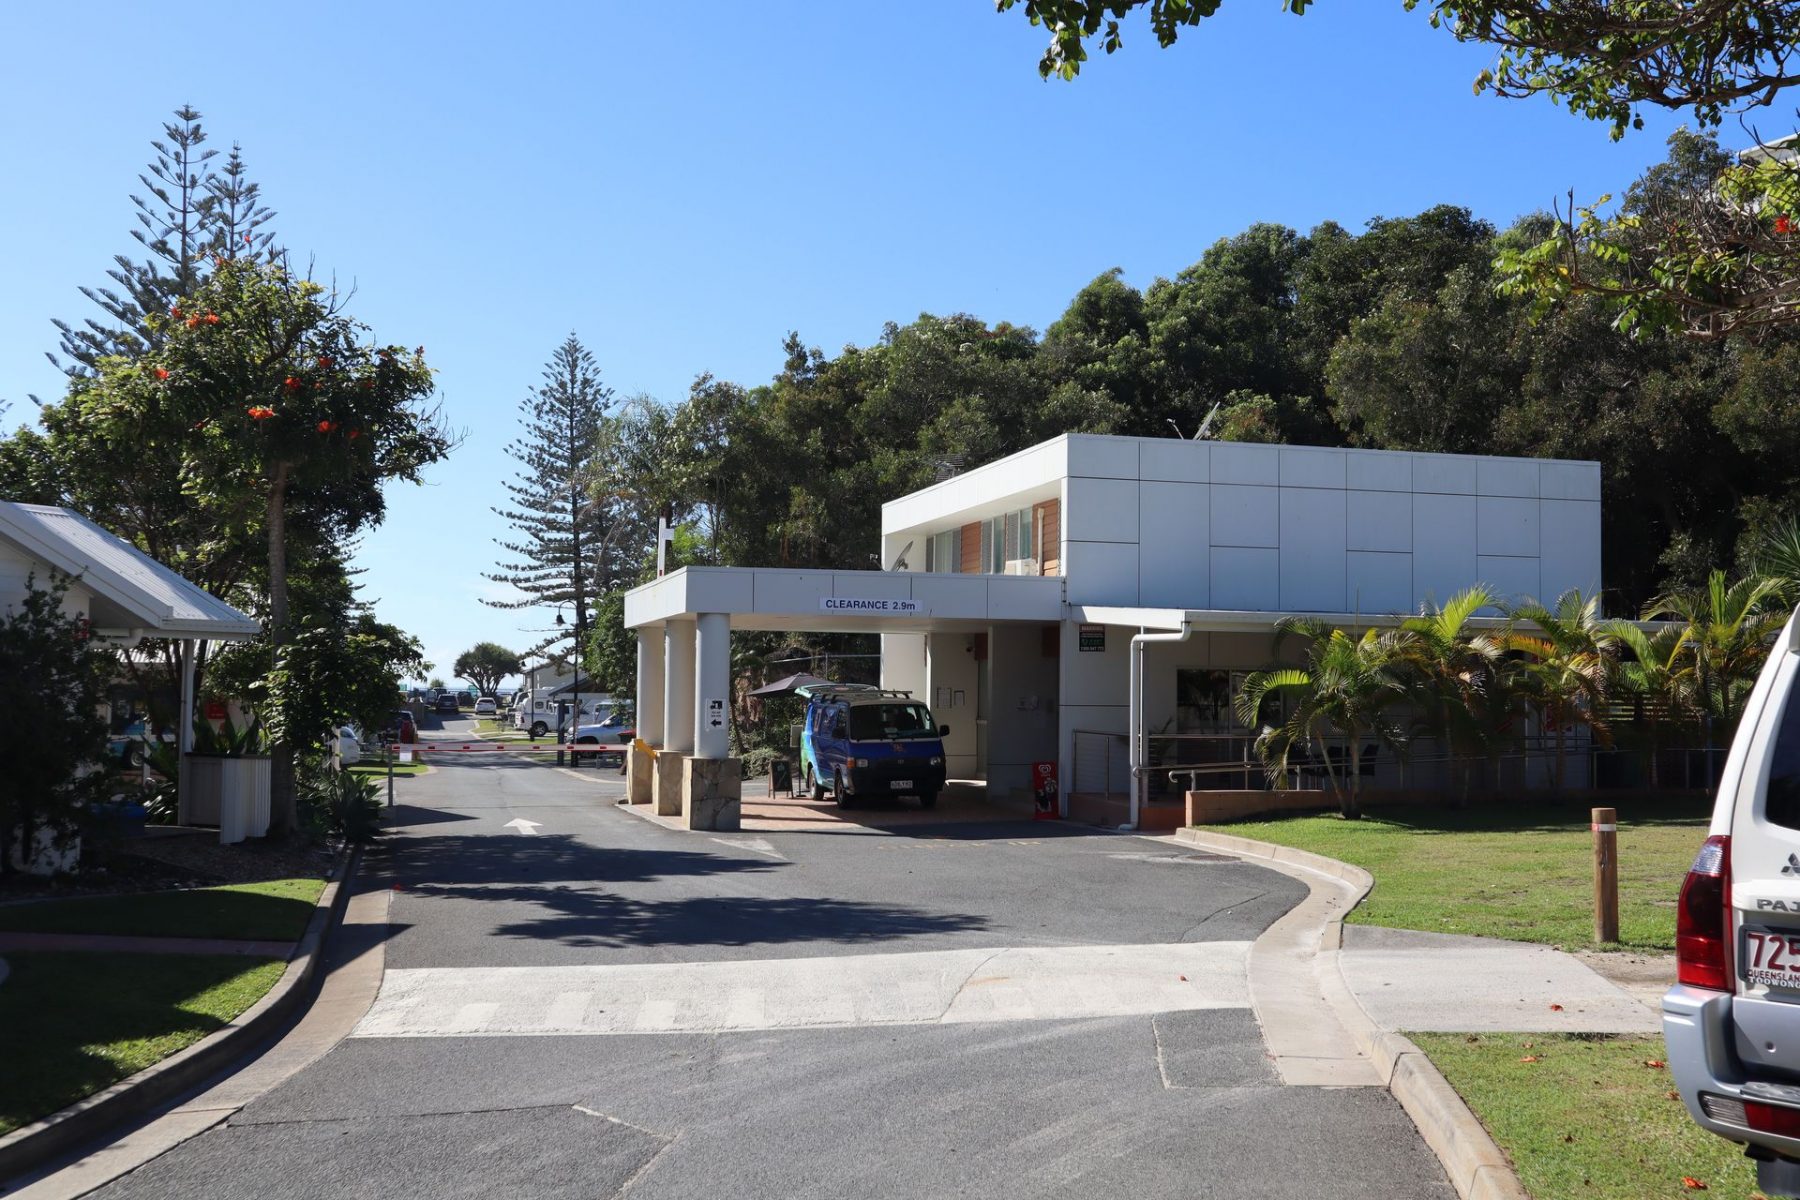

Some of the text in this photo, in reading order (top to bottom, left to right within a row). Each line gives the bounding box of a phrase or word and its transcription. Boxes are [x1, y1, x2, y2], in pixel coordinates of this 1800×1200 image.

[825, 599, 916, 610] CLEARANCE 2.9m
[1747, 933, 1800, 972] 725
